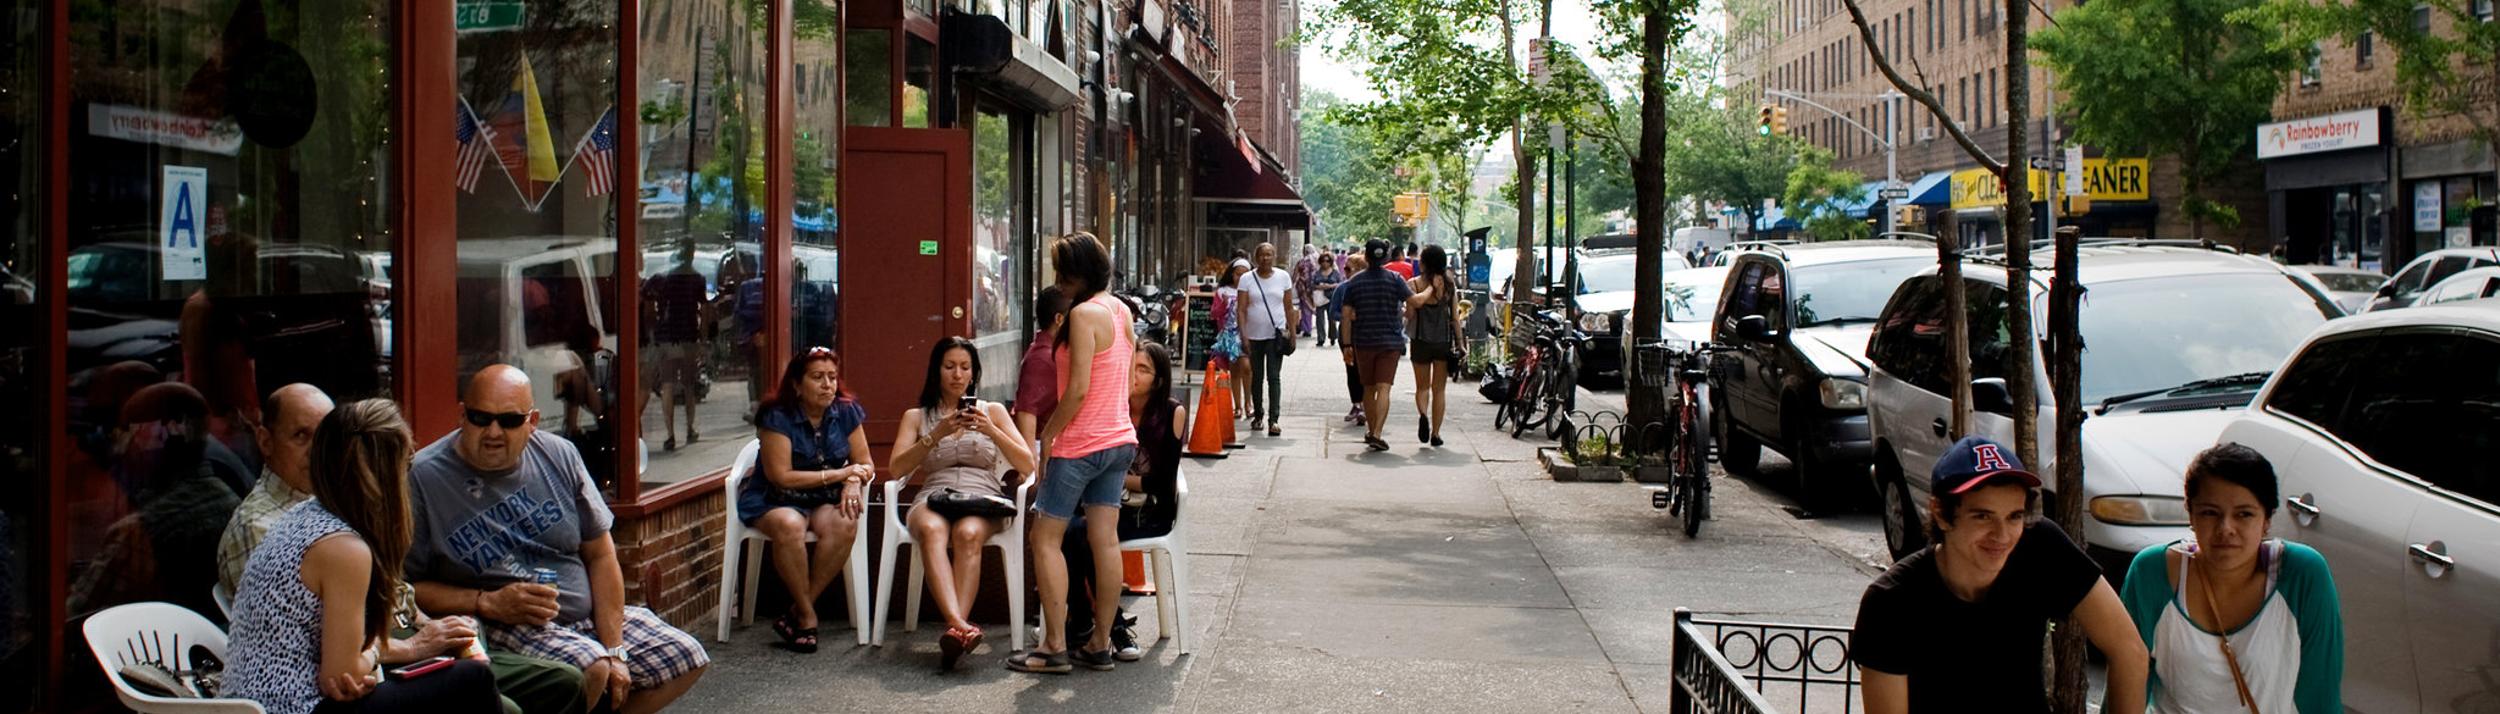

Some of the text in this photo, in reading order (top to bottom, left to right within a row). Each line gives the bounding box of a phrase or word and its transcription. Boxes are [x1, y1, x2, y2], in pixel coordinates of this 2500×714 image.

[2287, 117, 2359, 141] Rainbowberry
[168, 181, 198, 249] A
[1475, 238, 1484, 251] P
[1973, 444, 2011, 471] A
[447, 486, 538, 557] NEW YORK
[462, 500, 564, 575] YANKEES
